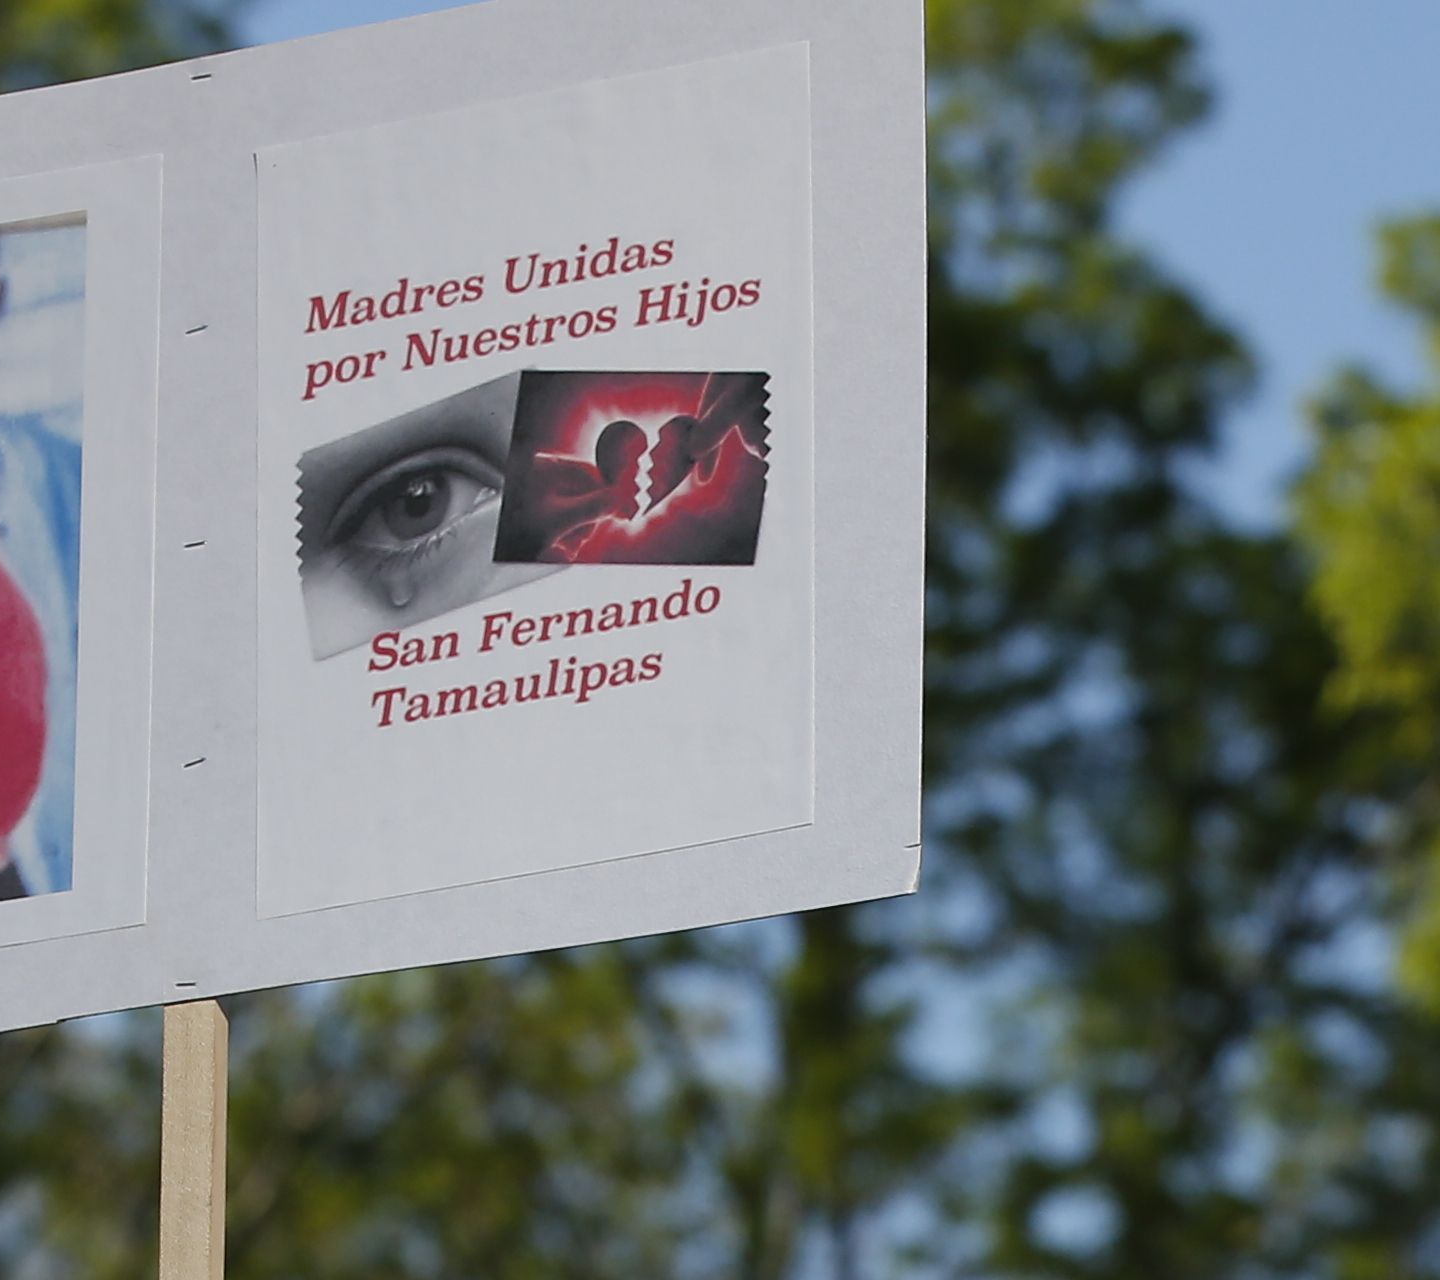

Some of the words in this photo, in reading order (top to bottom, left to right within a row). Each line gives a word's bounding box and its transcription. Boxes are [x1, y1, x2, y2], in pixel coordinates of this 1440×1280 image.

[304, 277, 485, 334] Madres
[504, 236, 675, 295] Unidas
[301, 345, 386, 401] por
[402, 300, 618, 371] Nuestros
[633, 276, 762, 328] Hijos
[367, 628, 460, 673] San
[478, 578, 721, 654] Fernando
[370, 650, 663, 728] Tamaulipas
